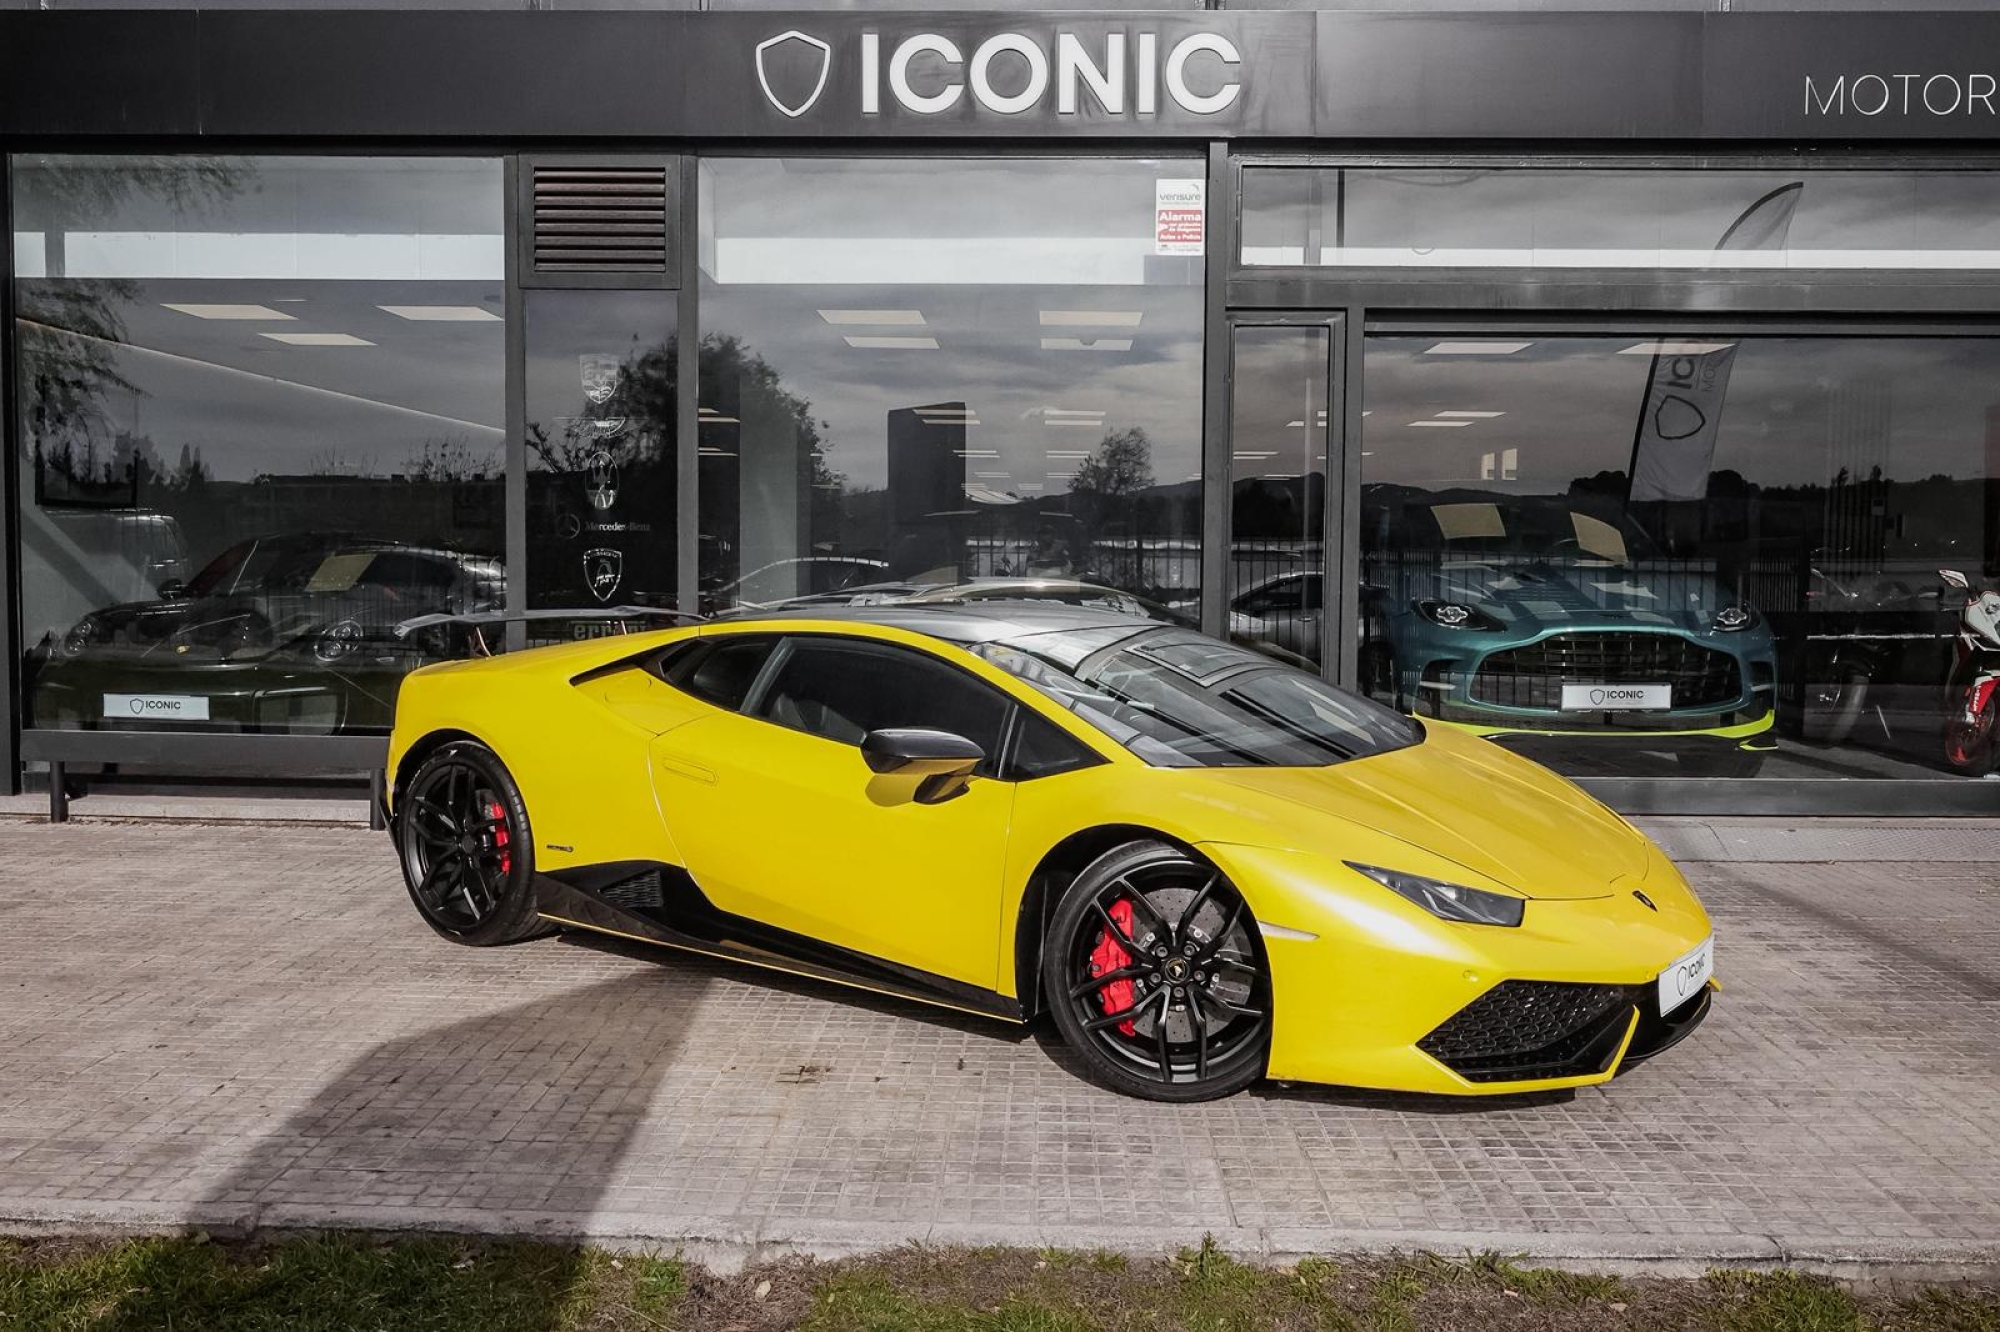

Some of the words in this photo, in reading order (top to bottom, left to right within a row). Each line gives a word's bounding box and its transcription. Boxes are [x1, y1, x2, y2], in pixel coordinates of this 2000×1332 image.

[862, 33, 1241, 115] ICONIC
[1804, 74, 1996, 116] MOTOR
[1159, 193, 1202, 201] verisure
[1159, 211, 1202, 222] Alarma
[584, 521, 651, 532] Mercedes-Benz
[570, 620, 646, 640] errari
[1606, 690, 1645, 699] ICONIC
[145, 700, 181, 710] ICONIC
